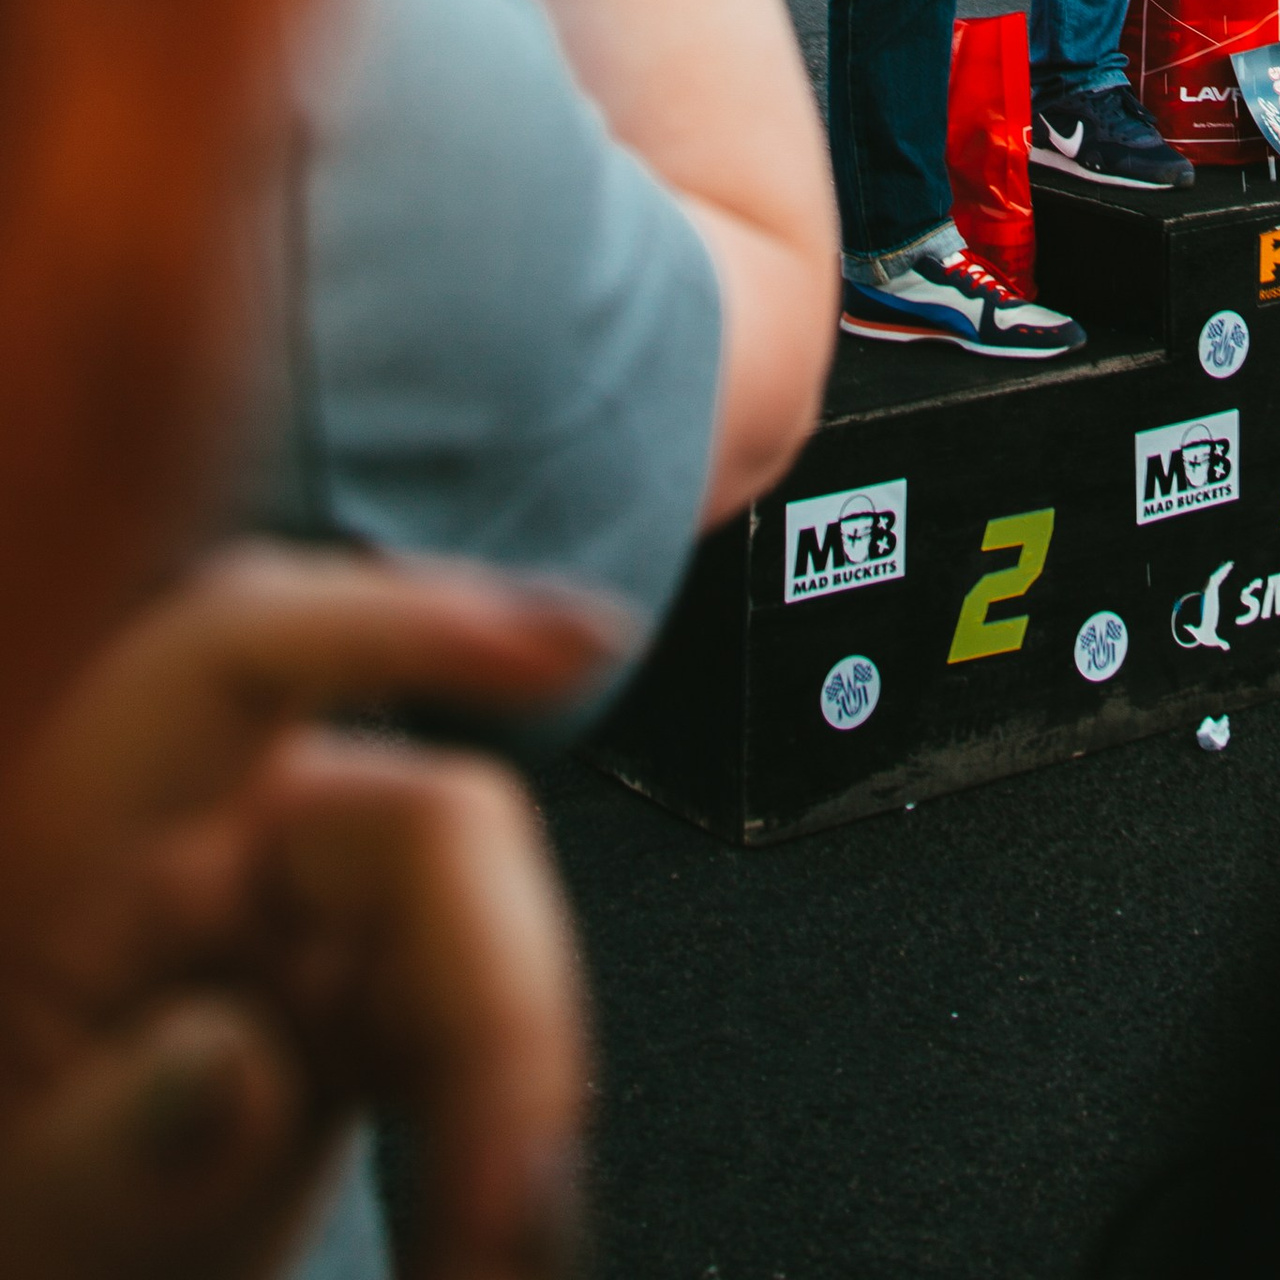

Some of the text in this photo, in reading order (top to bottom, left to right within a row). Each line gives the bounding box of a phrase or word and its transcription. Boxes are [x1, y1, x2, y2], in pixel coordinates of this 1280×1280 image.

[1142, 483, 1233, 518] MAD BUCKETS
[792, 559, 898, 597] MAD BUCKETS
[946, 506, 1056, 665] 2
